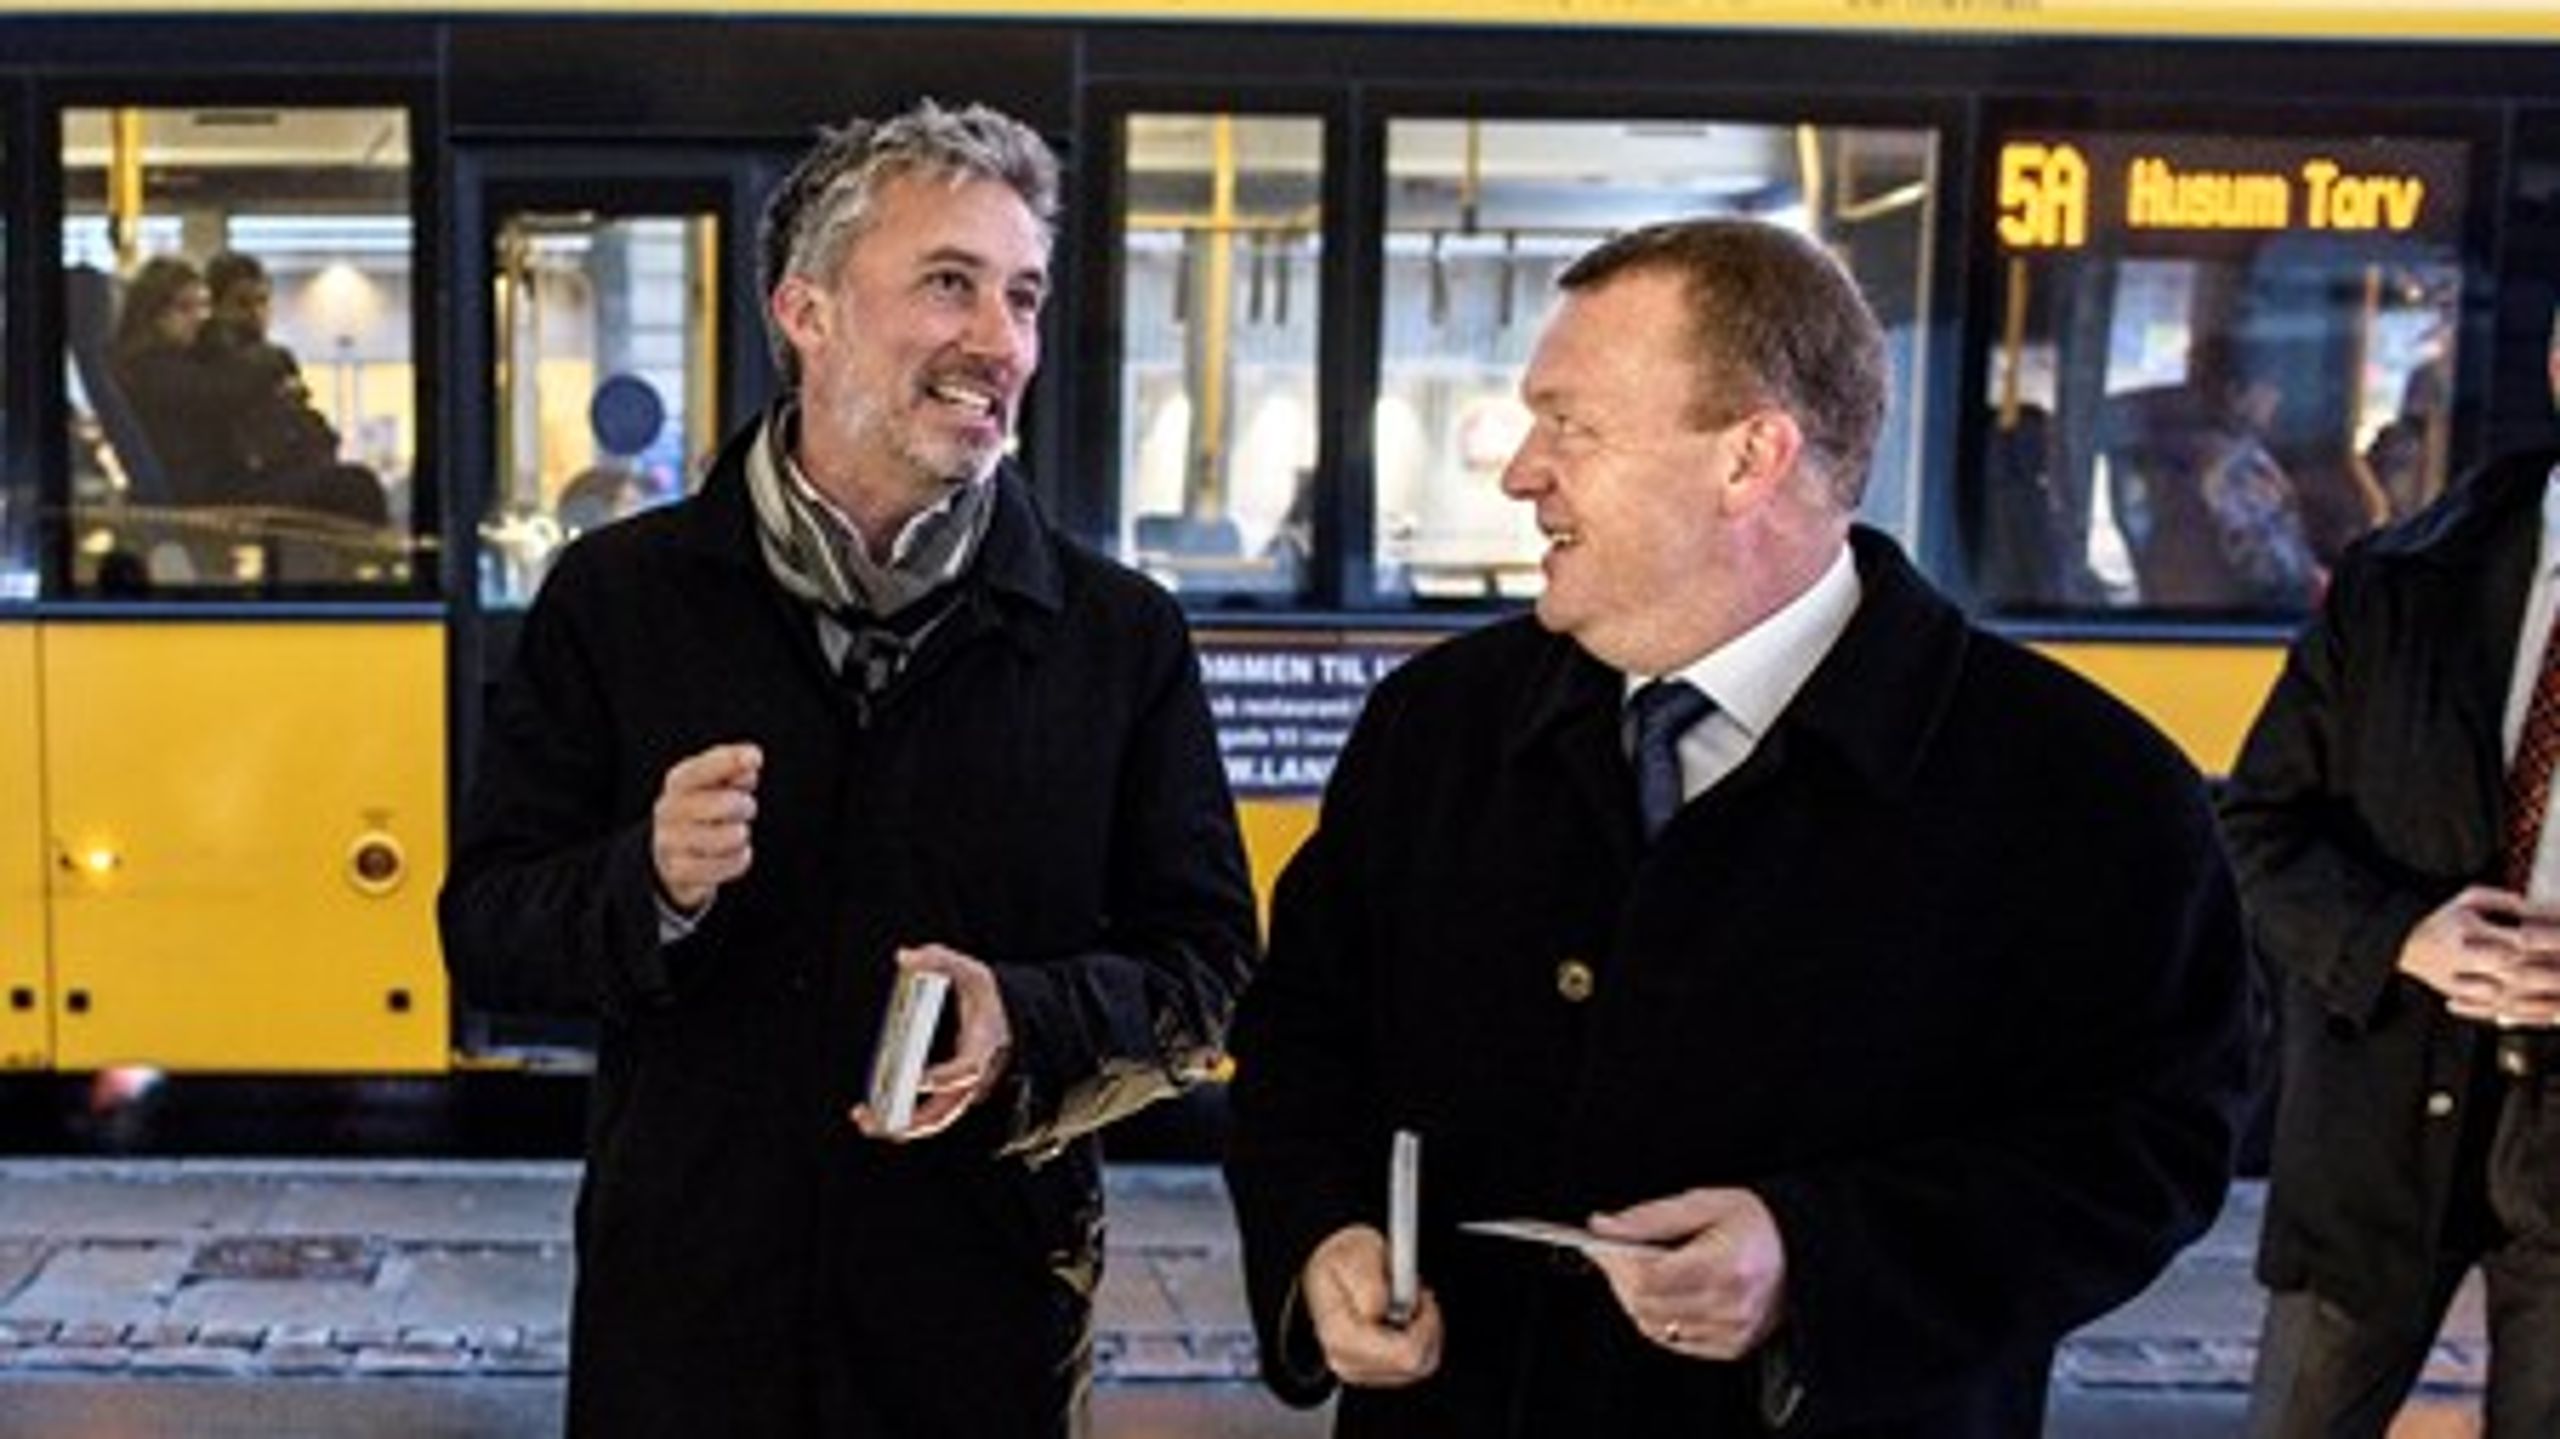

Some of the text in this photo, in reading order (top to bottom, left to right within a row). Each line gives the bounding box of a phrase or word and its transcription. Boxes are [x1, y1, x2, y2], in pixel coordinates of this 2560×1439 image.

[1997, 143, 2423, 246] 5A Husum Torv
[1319, 654, 1366, 684] TIL
